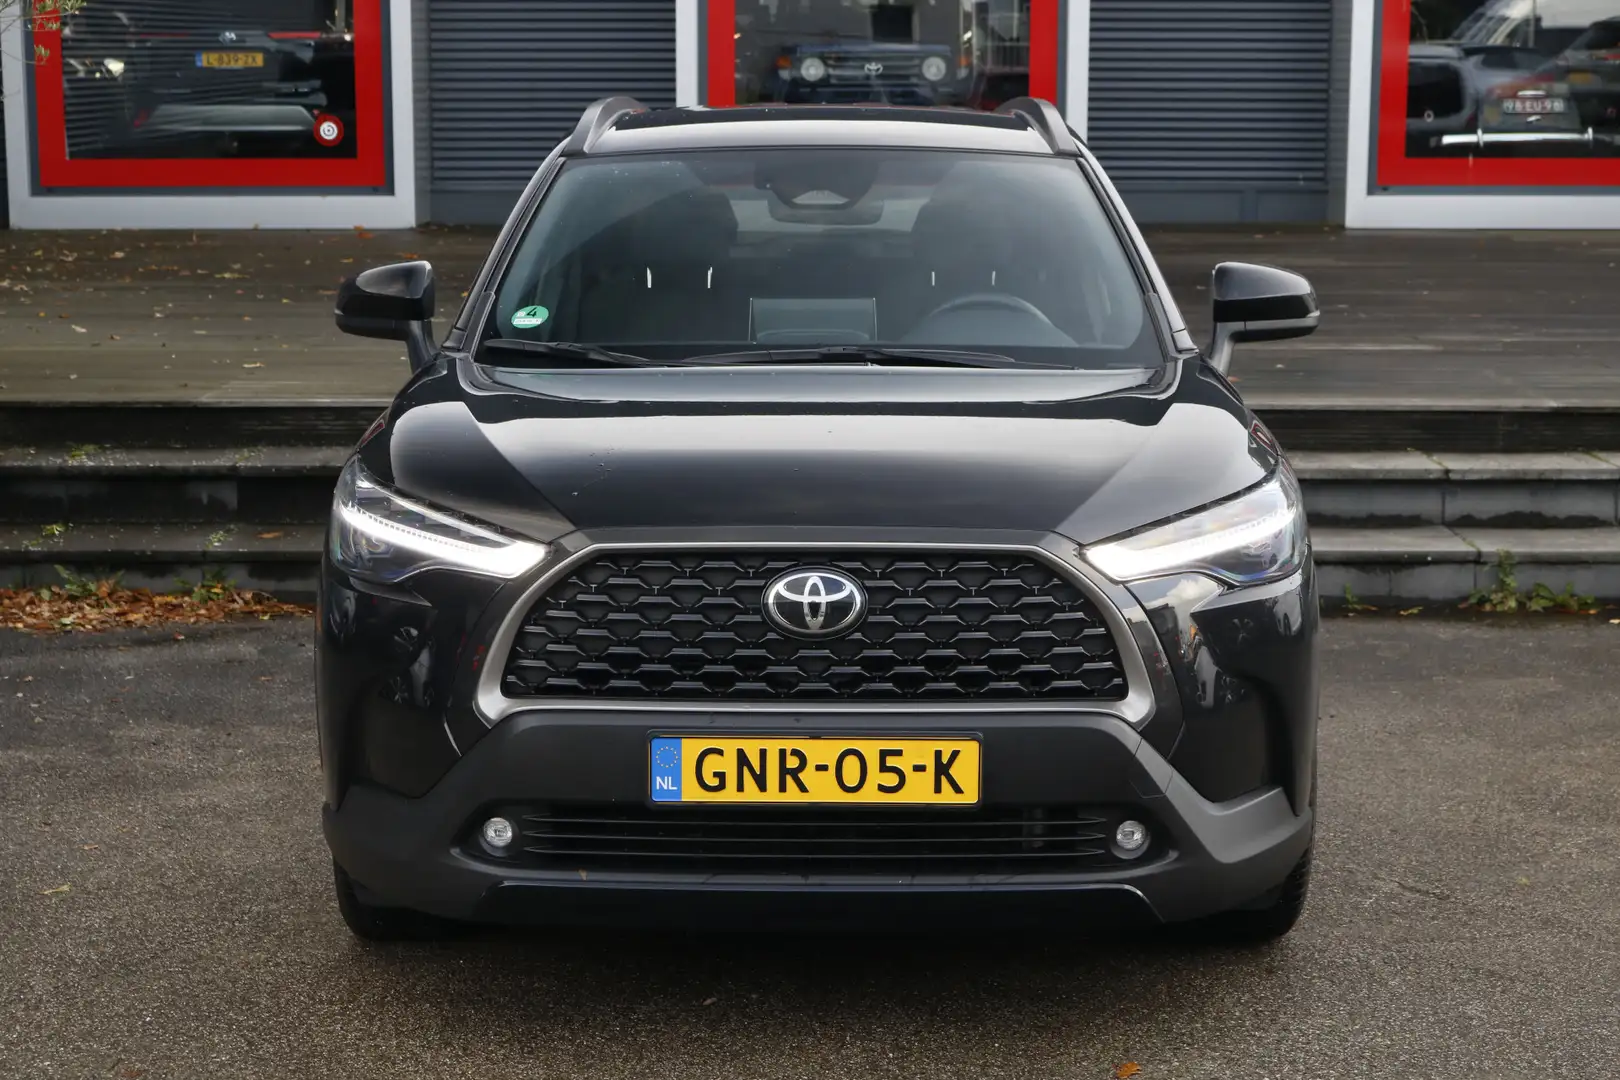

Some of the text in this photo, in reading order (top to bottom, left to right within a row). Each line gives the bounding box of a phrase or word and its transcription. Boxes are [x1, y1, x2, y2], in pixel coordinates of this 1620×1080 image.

[526, 306, 538, 318] 4
[695, 746, 965, 794] GNR-05-K
[656, 776, 677, 791] NL
